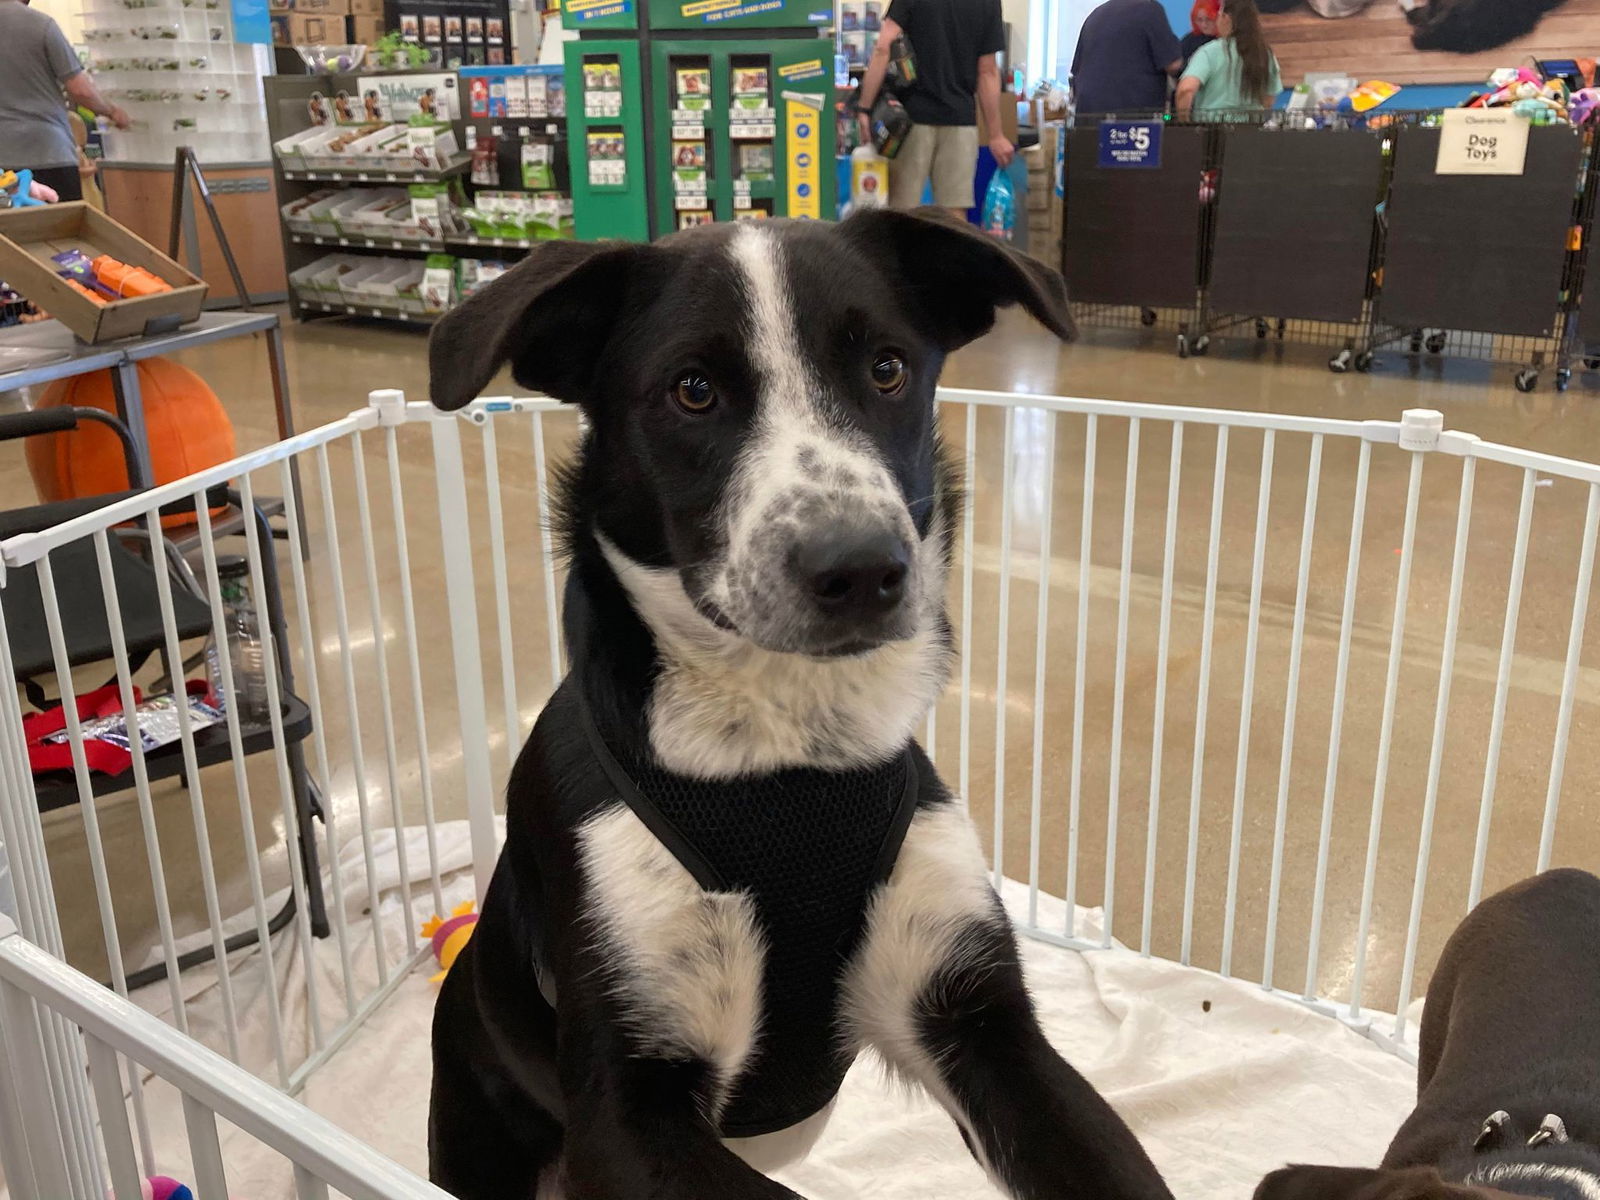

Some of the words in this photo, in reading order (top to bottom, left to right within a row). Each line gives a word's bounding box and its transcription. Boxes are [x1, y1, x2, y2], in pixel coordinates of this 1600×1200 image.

[1110, 128, 1117, 139] 2
[1129, 126, 1150, 150] $5
[1469, 134, 1498, 148] Dog
[1466, 147, 1497, 162] Toys
